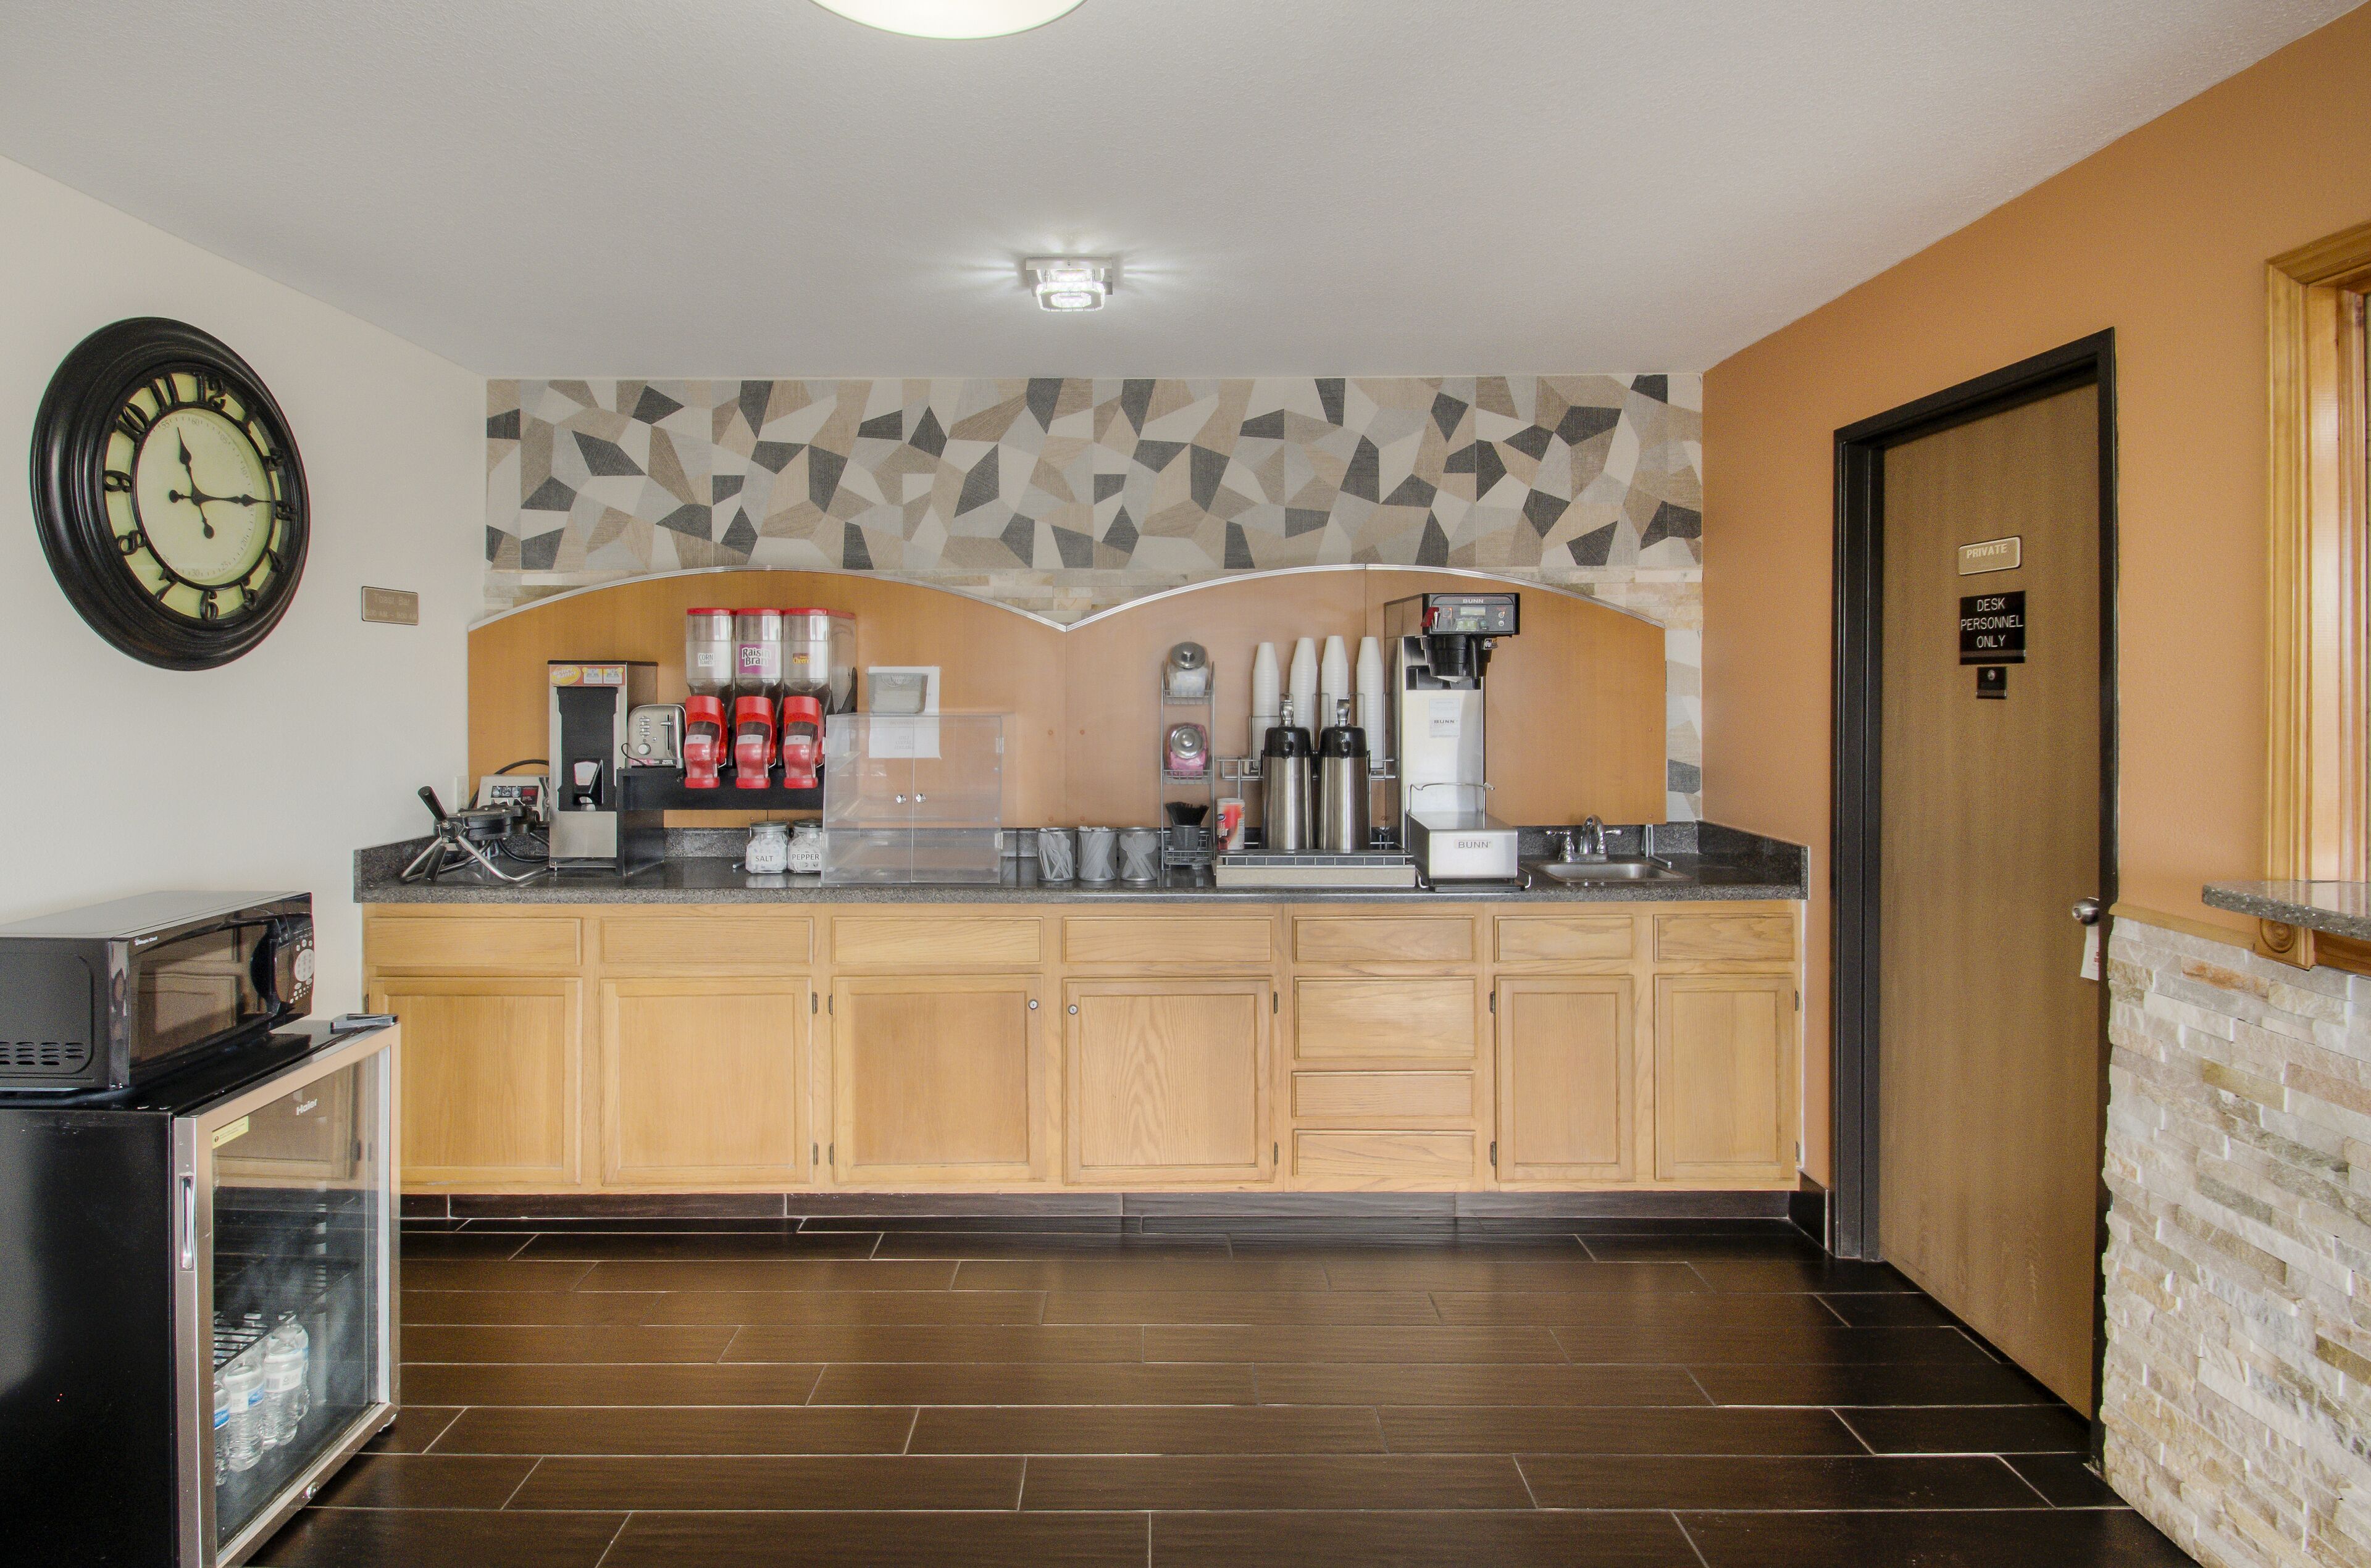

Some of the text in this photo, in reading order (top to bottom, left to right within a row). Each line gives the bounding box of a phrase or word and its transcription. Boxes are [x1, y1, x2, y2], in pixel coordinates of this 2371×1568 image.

[149, 373, 180, 411] 11
[194, 372, 227, 412] 12
[115, 402, 150, 447] 10
[104, 469, 132, 493] 9
[118, 530, 147, 556] 8
[1967, 543, 2007, 559] PRIVATE
[155, 567, 179, 602] 7
[199, 590, 219, 621] 6
[1977, 597, 2005, 612] DESK
[1960, 615, 2024, 632] PERSONNEL
[1976, 635, 2006, 648] ONLY
[742, 648, 771, 658] Raisin
[745, 657, 769, 666] Bran
[296, 1098, 318, 1116] Haier
